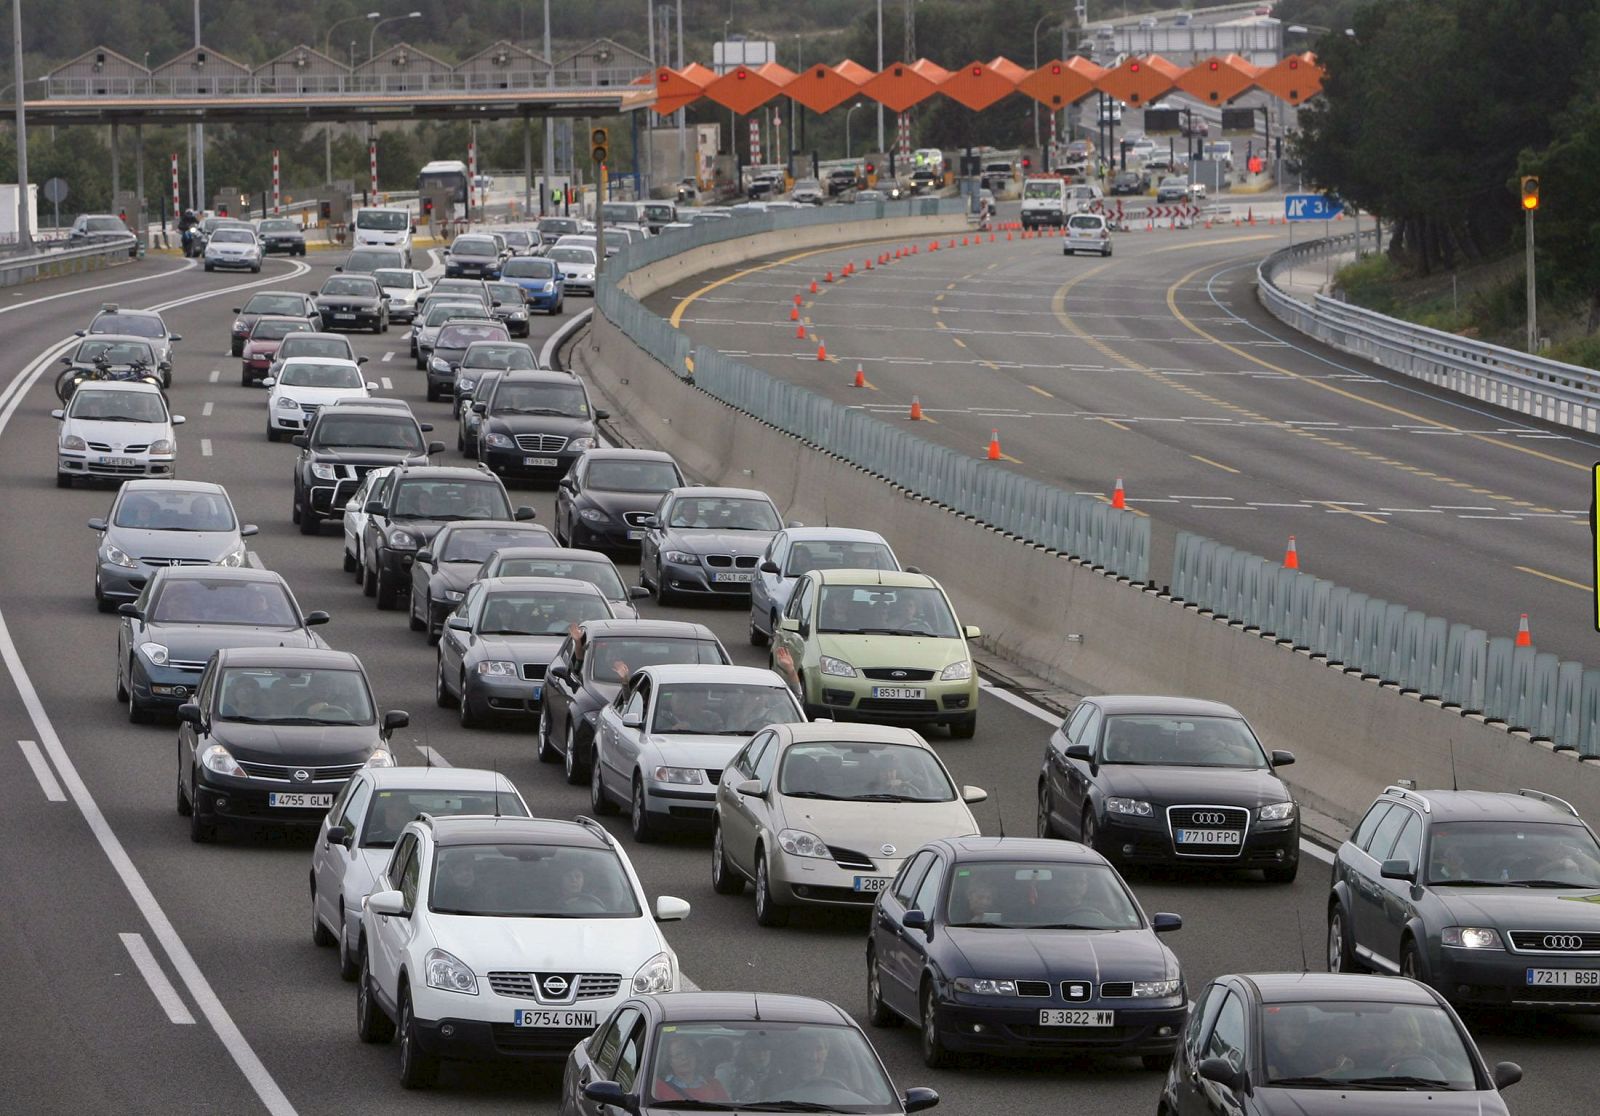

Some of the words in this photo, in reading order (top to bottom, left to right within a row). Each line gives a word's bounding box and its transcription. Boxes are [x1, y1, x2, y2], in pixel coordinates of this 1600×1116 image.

[879, 688, 900, 698] 8531
[278, 793, 304, 805] 4755
[310, 795, 330, 806] GLM
[1184, 831, 1213, 843] 7710
[1216, 832, 1238, 844] FPC
[1536, 971, 1567, 984] 7211
[1574, 971, 1598, 984] BSB
[523, 1013, 560, 1025] 6754
[564, 1013, 593, 1027] GNM
